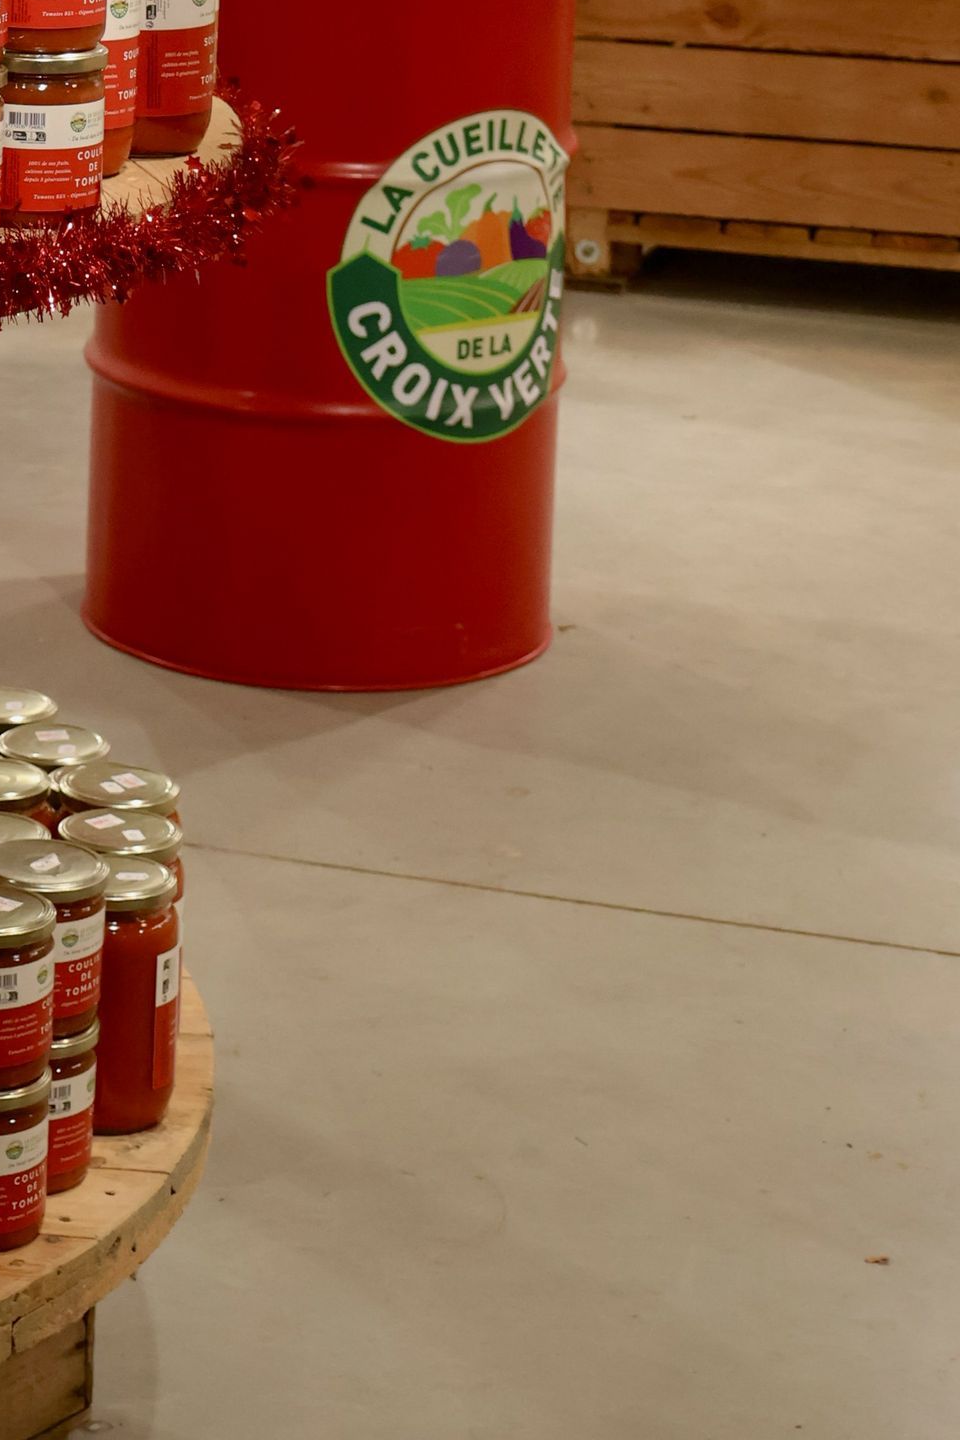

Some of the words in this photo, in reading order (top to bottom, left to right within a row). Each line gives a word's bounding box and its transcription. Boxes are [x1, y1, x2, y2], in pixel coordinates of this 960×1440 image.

[123, 48, 139, 61] SOUP
[119, 88, 137, 100] TOMA
[89, 162, 98, 172] DE
[75, 173, 102, 188] TOMAT
[361, 185, 414, 234] LA
[457, 338, 483, 360] DE
[490, 336, 511, 355] LA
[348, 301, 479, 428] CROIX
[81, 971, 92, 981] DE
[27, 1181, 37, 1193] DE
[12, 1190, 42, 1210] TOMA
